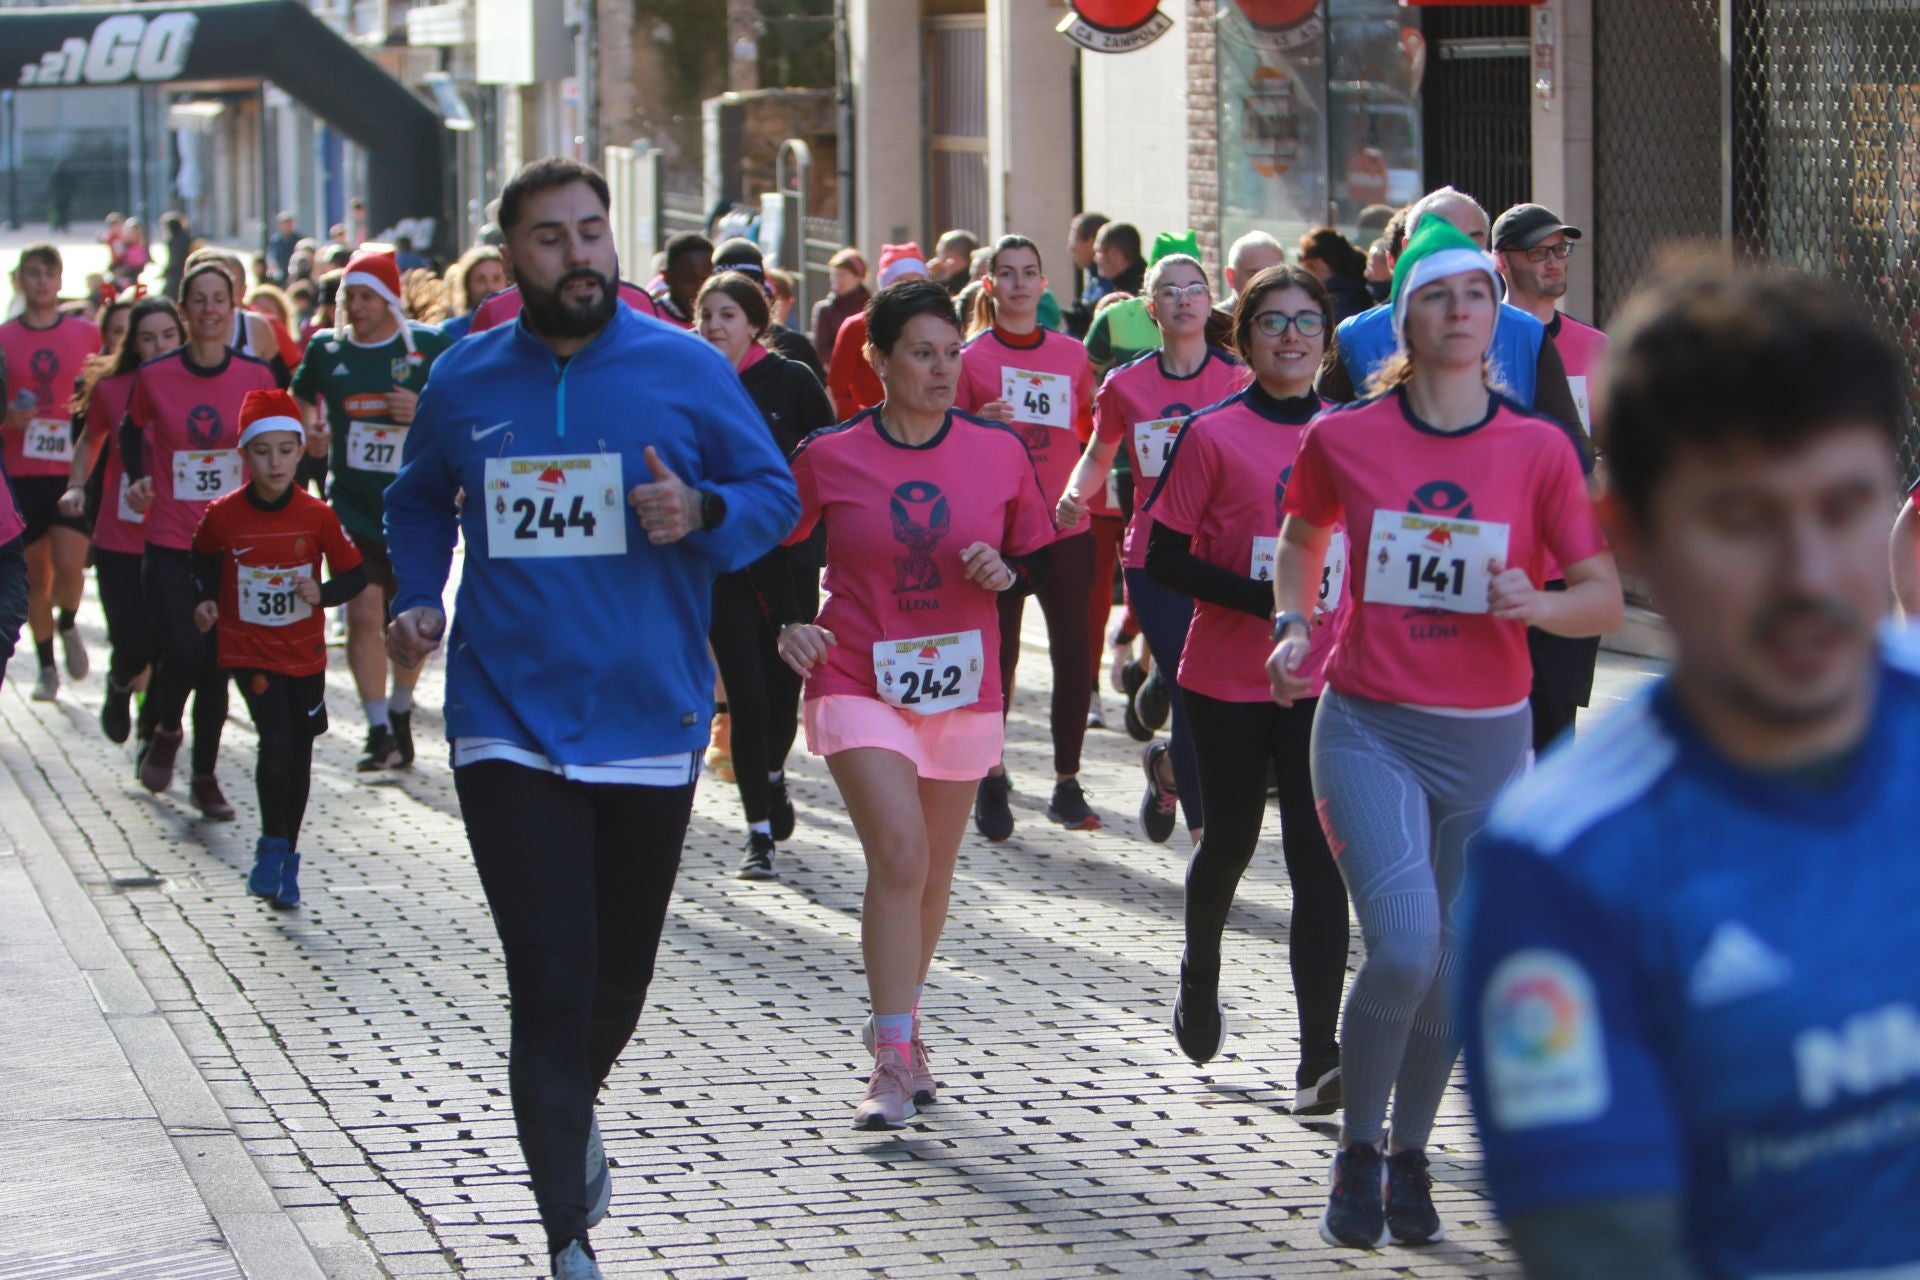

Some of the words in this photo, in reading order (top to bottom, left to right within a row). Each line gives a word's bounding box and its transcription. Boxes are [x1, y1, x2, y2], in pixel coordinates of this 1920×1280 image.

[1023, 390, 1051, 415] 46
[363, 442, 395, 464] 217
[195, 469, 221, 492] 35
[512, 495, 597, 540] 244
[1406, 554, 1466, 596] 141
[257, 591, 295, 616] 381
[897, 598, 940, 611] LLENA
[1409, 624, 1460, 641] LLENA
[900, 665, 962, 705] 242
